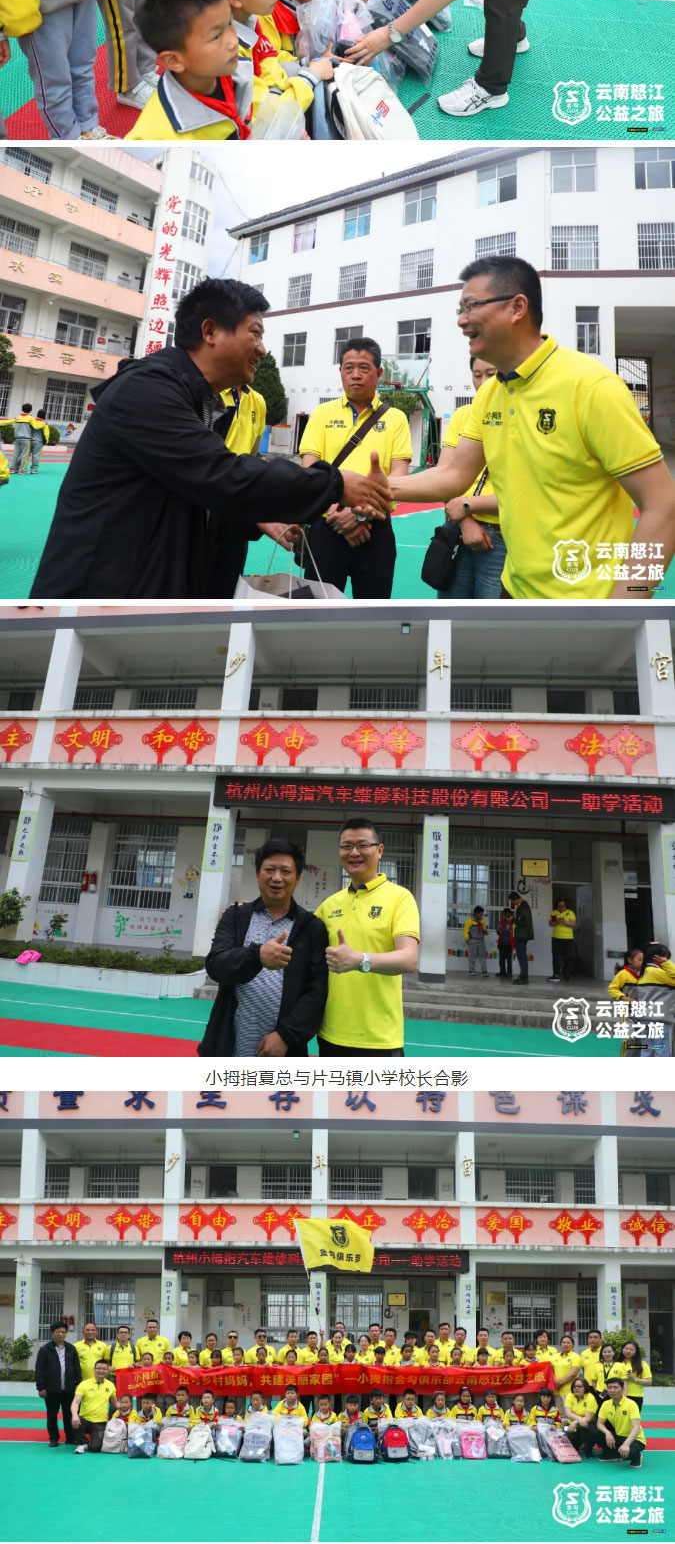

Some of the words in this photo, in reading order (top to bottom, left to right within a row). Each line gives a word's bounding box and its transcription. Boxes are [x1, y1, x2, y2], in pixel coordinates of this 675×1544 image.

[145, 194, 182, 358] 党的光辉照边疆
[63, 728, 111, 750] 文明
[151, 729, 205, 751] 和谐
[253, 728, 305, 750] 自由
[354, 728, 411, 754] 平等
[468, 732, 528, 753] 公正
[580, 734, 641, 757] 法治
[45, 1212, 81, 1229] 文明
[114, 1212, 154, 1229] 和谐
[189, 1211, 228, 1229] 自由
[412, 1214, 452, 1231] 法治
[486, 1216, 525, 1233] 爱国
[557, 1216, 598, 1233] 敬业
[628, 1216, 668, 1235] 诚信
